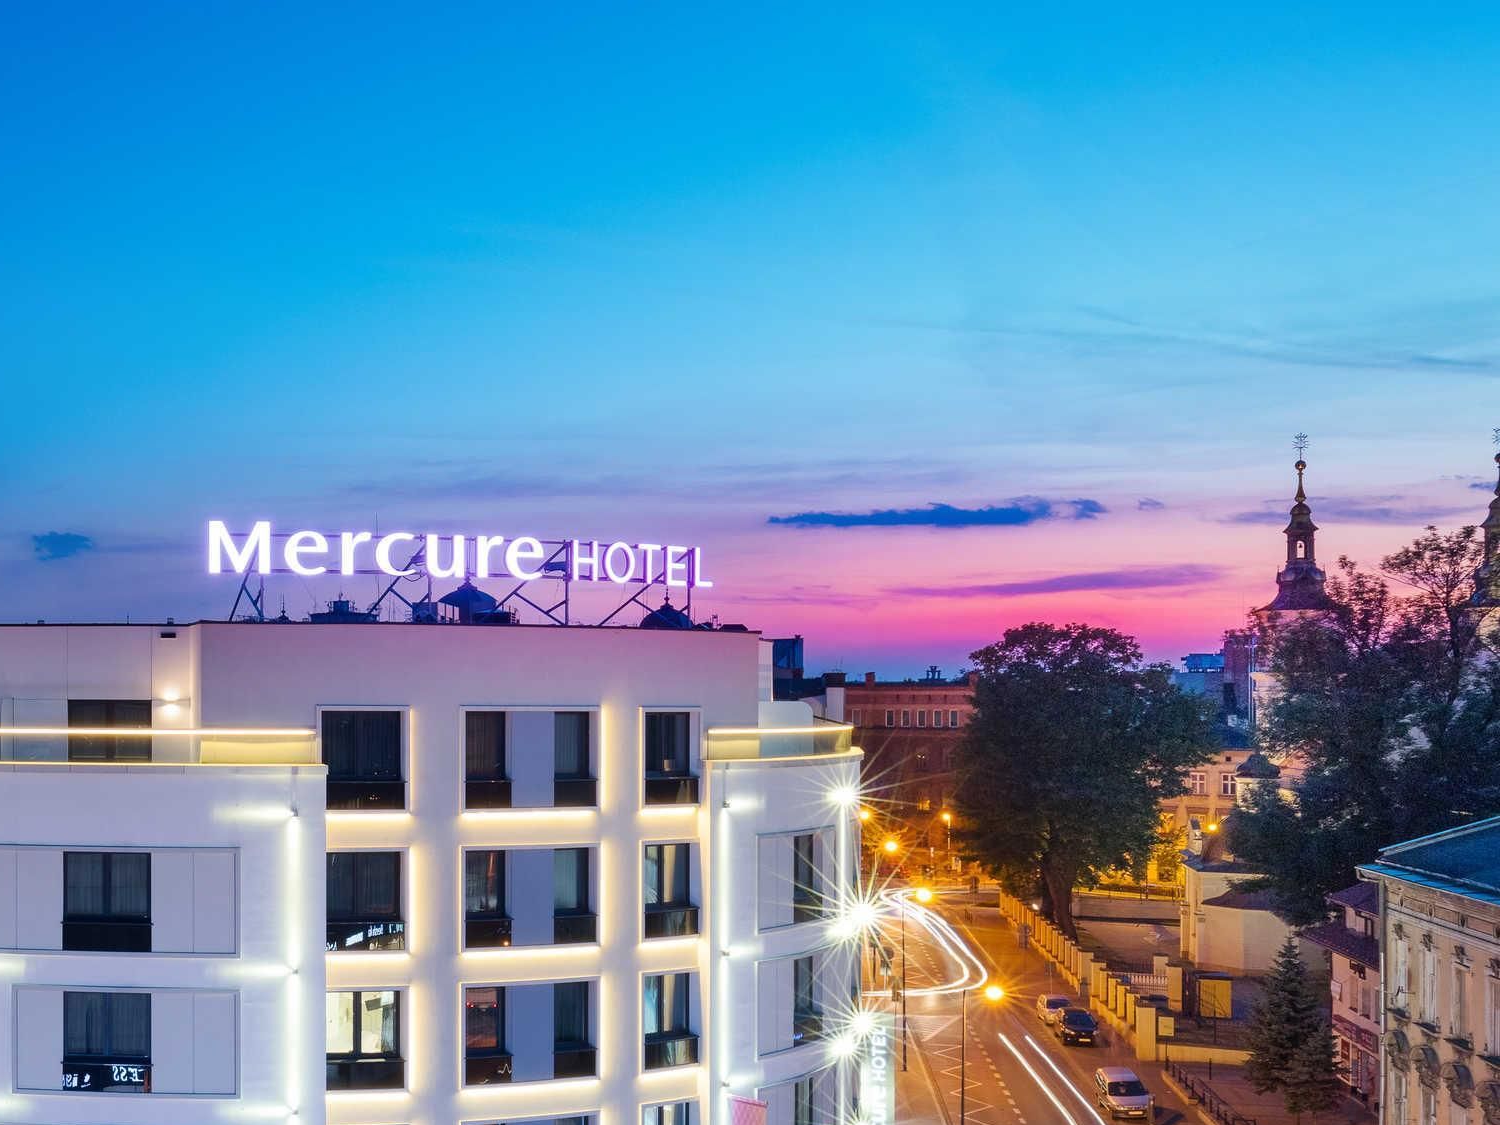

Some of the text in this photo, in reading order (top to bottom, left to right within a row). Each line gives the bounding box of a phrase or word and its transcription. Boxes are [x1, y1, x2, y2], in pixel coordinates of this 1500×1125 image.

[207, 520, 714, 588] Mercure HOTEL
[870, 1024, 887, 1082] HOTEL
